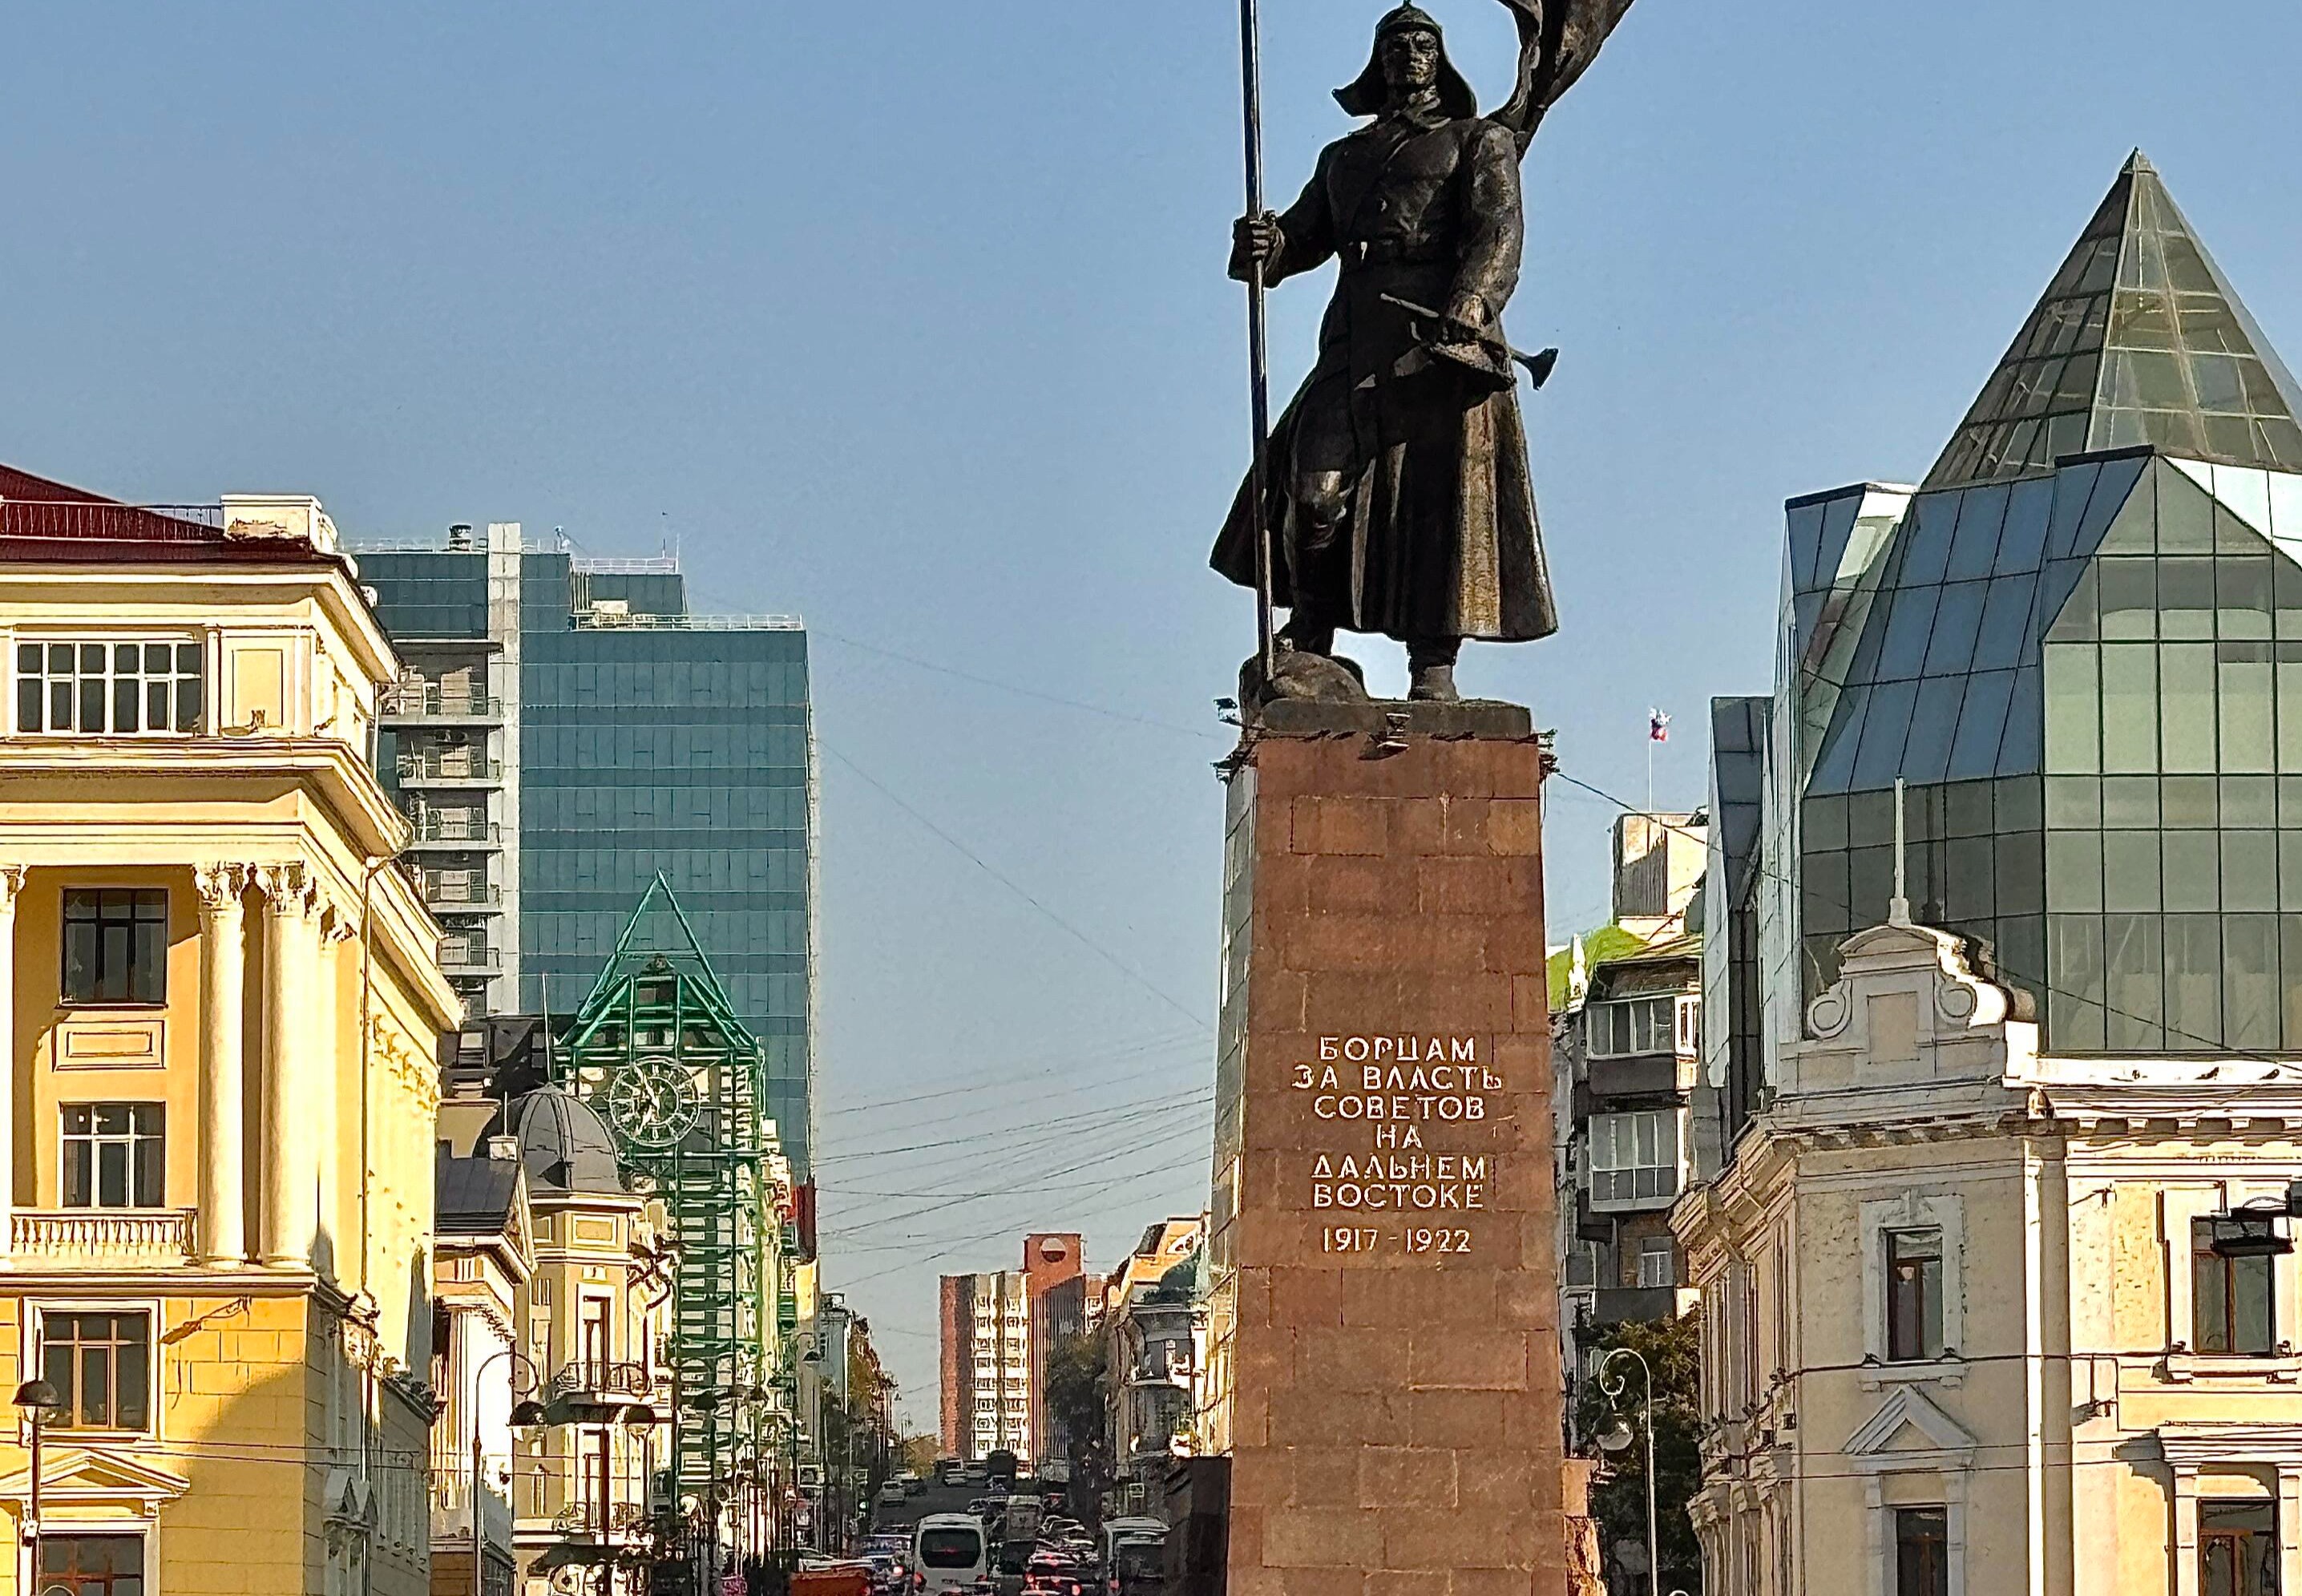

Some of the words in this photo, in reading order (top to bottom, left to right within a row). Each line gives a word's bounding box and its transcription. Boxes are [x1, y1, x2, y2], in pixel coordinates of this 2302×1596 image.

[1320, 1036, 1475, 1062] БОРЦАМ
[1292, 1064, 1338, 1089] ЗА
[1363, 1065, 1502, 1090] ВЛАСТЬ
[1314, 1094, 1485, 1120] СОВЕТОВ
[1376, 1124, 1423, 1149] НА
[1311, 1154, 1486, 1180] ДАЛЬНЕМ
[1314, 1183, 1484, 1210] ВОСТОКЕ
